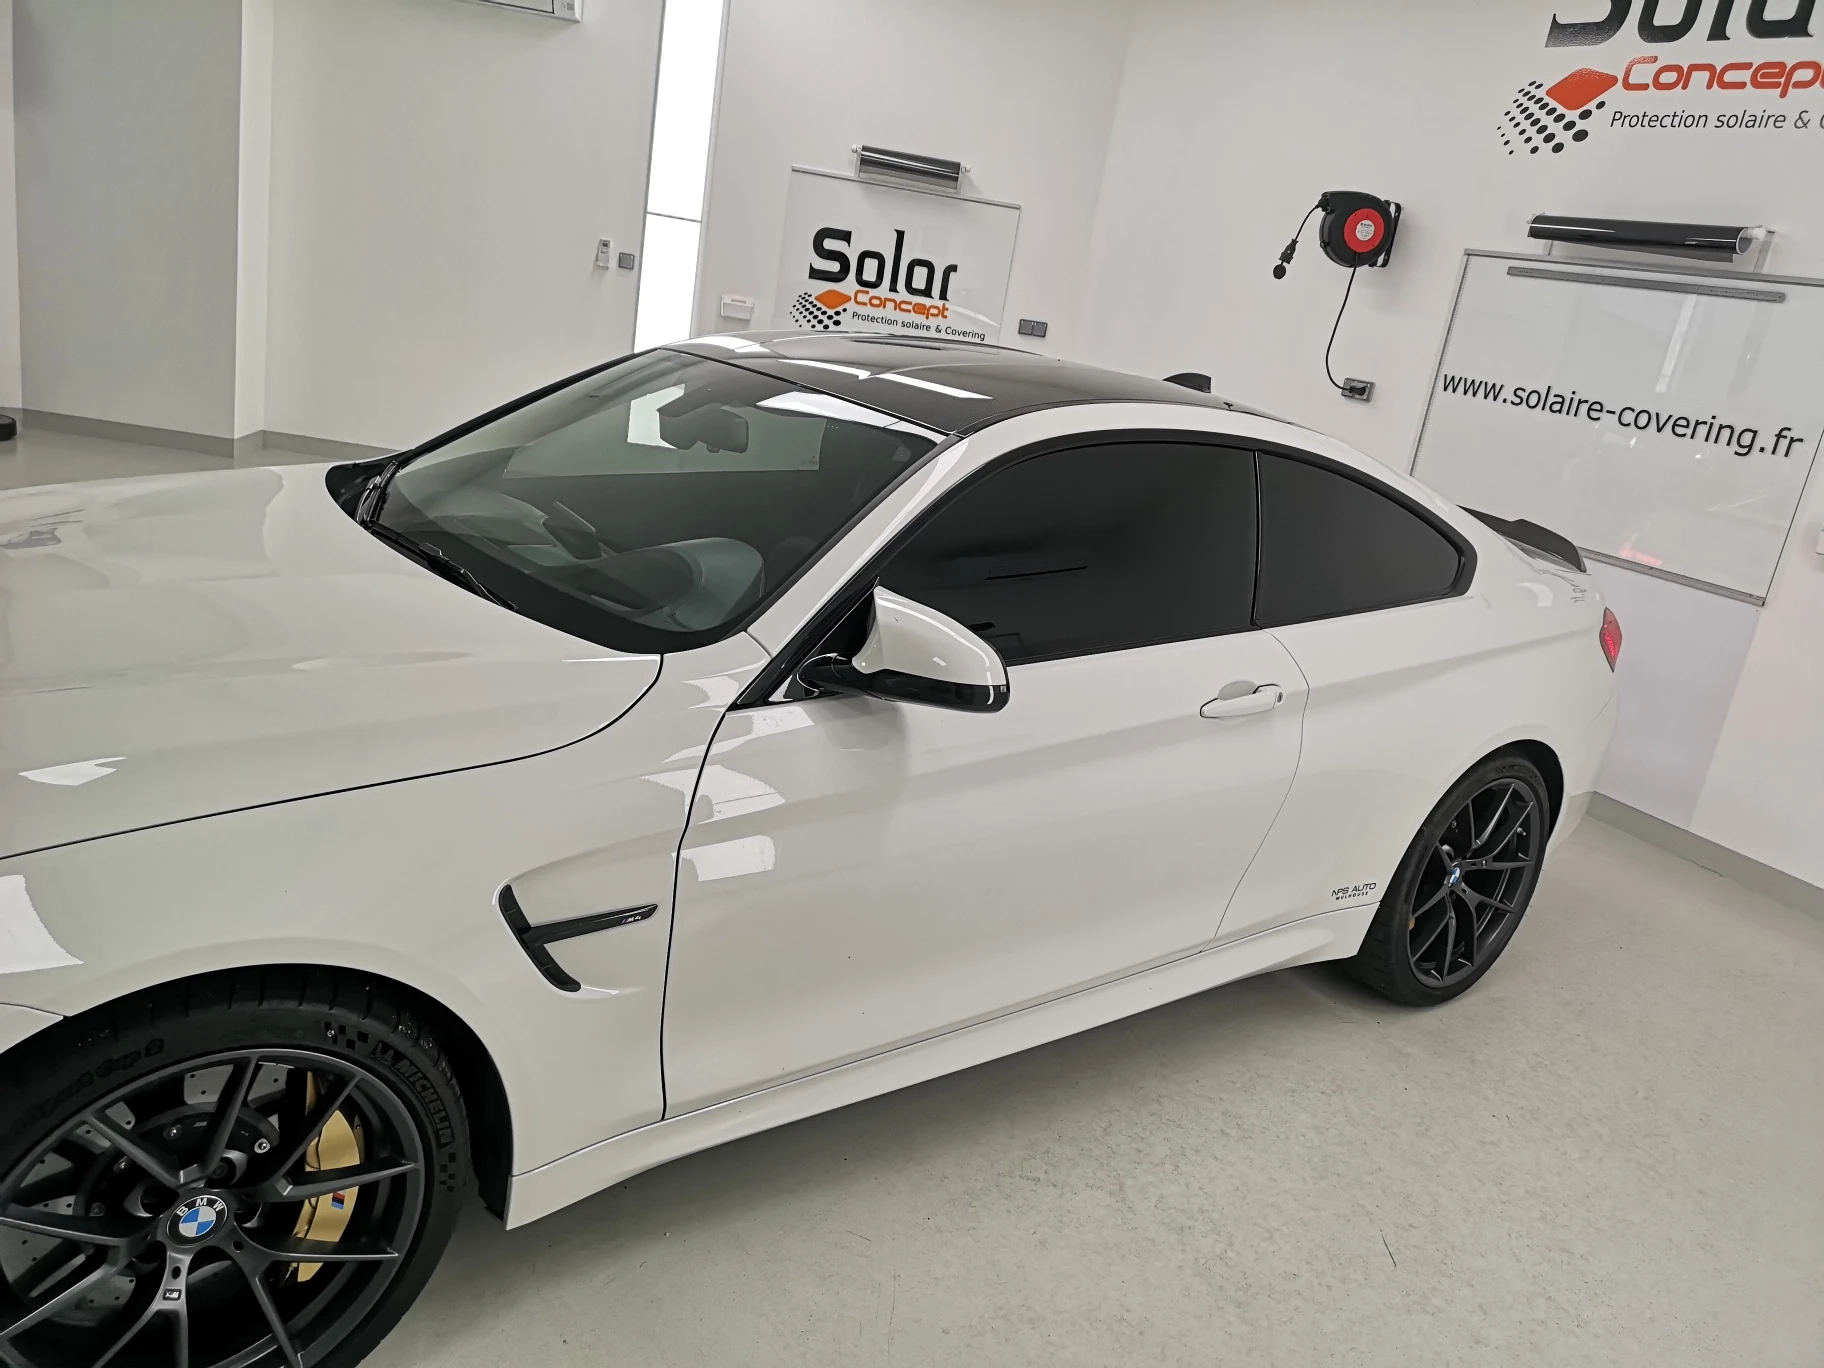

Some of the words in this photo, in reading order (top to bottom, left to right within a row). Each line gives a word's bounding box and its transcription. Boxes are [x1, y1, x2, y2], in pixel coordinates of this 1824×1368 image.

[1622, 55, 1824, 99] Concep
[1610, 109, 1709, 129] Protection
[1713, 109, 1787, 129] solaire
[1793, 109, 1811, 130] &
[808, 226, 958, 302] Solar
[853, 289, 949, 320] Concept
[852, 311, 898, 327] Protection
[900, 320, 931, 332] solaire
[934, 324, 943, 333] &
[945, 326, 986, 341] Covering
[1442, 372, 1805, 459] www.solaire-covering.fr
[1331, 887, 1350, 897] NPS
[1351, 882, 1377, 893] AUTO
[394, 1058, 454, 1145] MICHELIN
[176, 1197, 226, 1218] BMW
